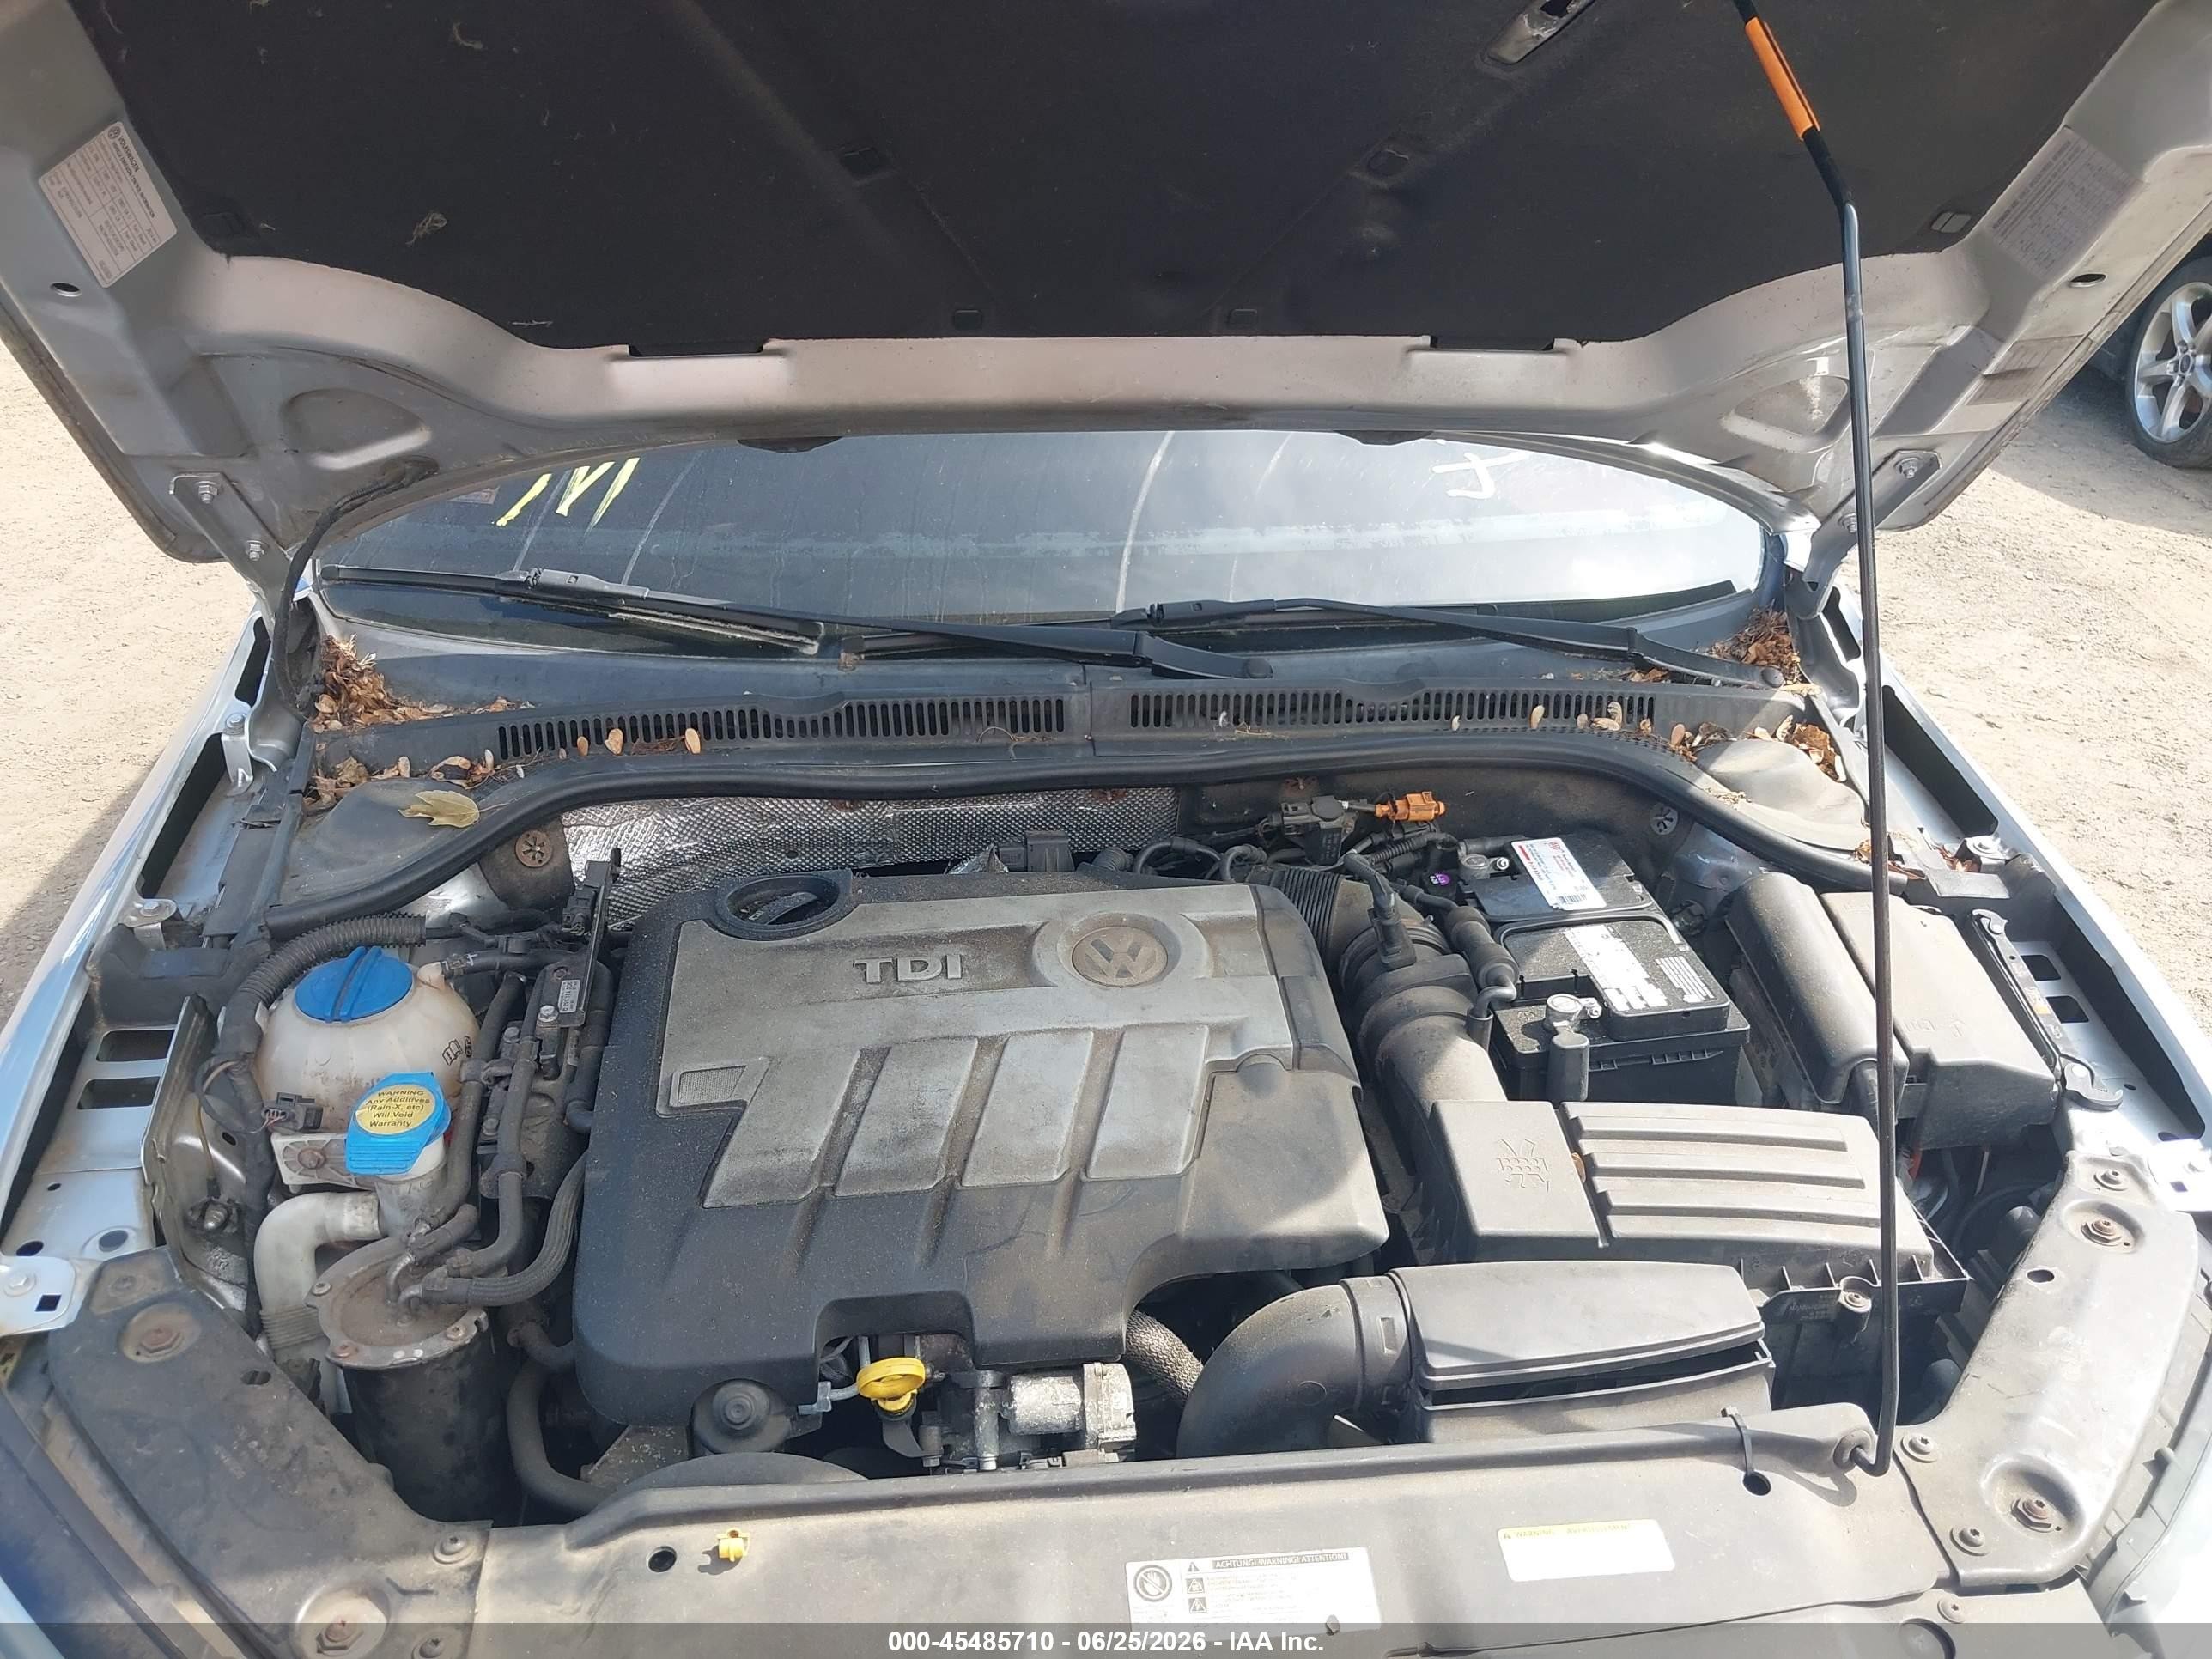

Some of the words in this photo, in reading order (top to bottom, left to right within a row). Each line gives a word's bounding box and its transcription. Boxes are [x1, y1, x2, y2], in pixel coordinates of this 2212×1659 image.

[117, 136, 141, 172] VOLKSWAGEN
[854, 954, 963, 984] TDI
[1215, 1558, 1256, 1569] ACHTUNG!
[1258, 1556, 1300, 1566] WARNING!
[1301, 1553, 1346, 1563] ATTENTION!
